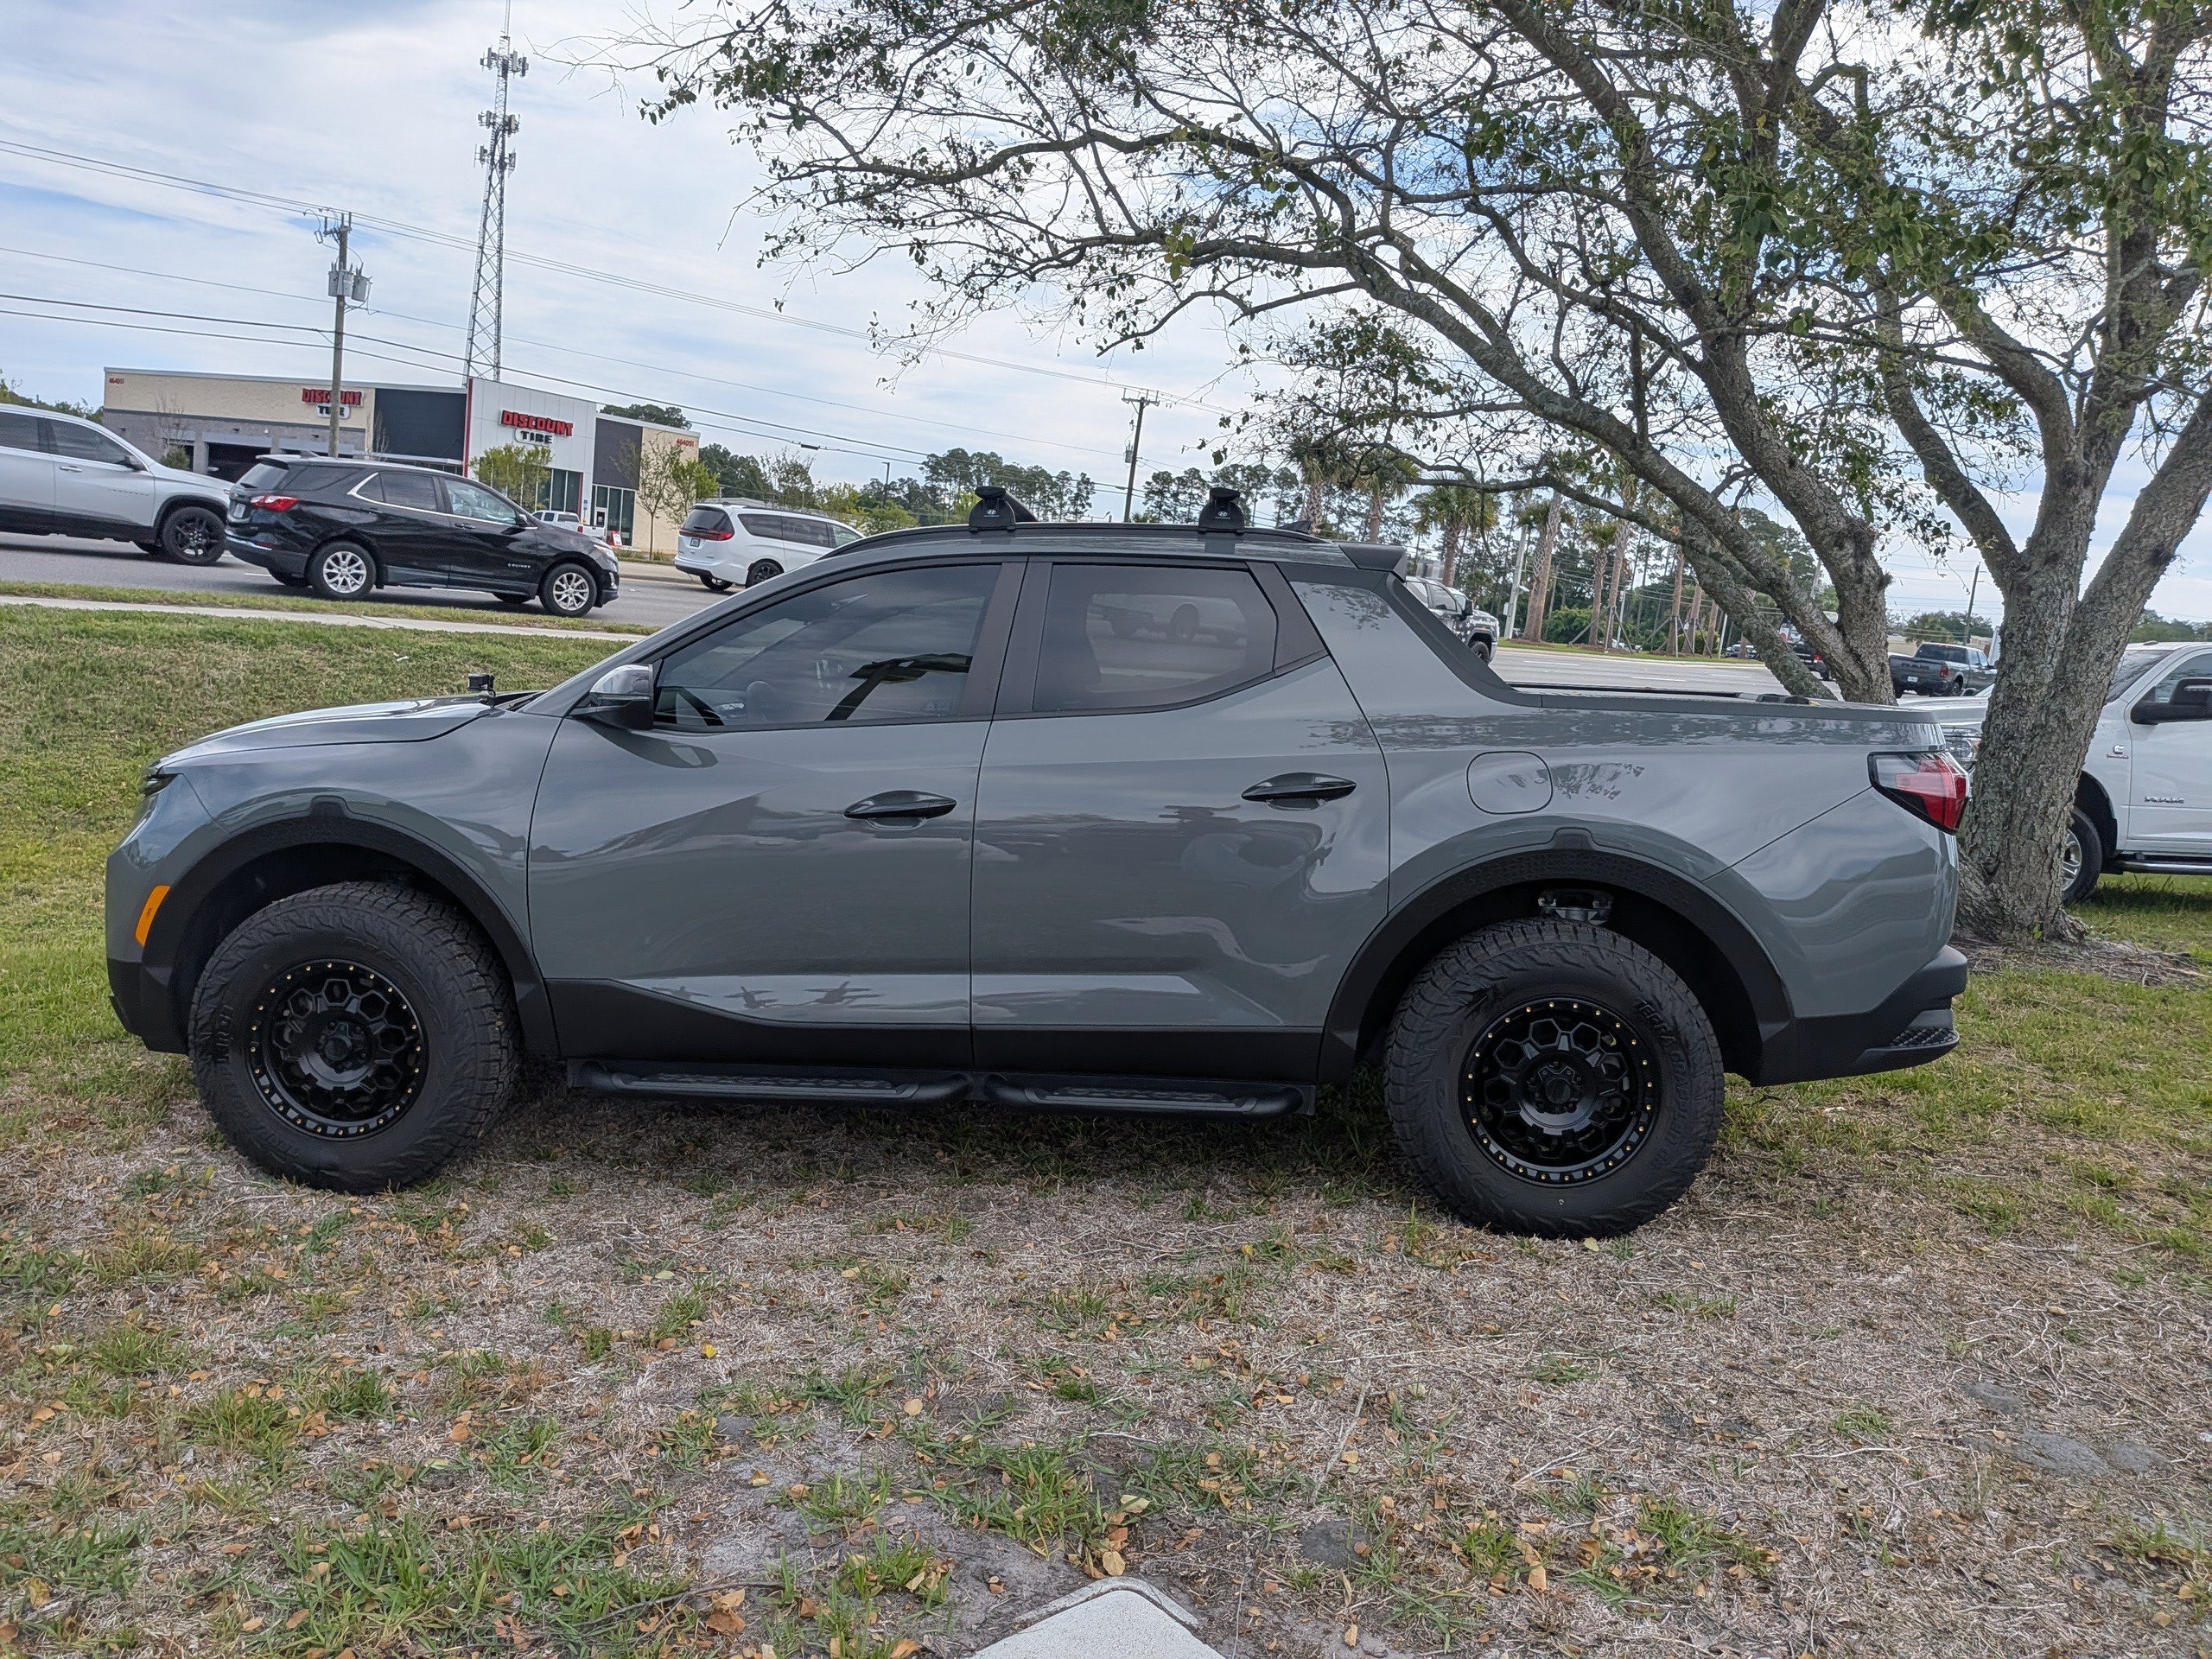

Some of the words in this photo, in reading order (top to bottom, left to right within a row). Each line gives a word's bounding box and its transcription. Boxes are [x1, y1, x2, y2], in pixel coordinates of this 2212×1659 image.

[302, 388, 362, 405] DISCUNT
[317, 404, 345, 416] TIE
[501, 410, 573, 436] DISCOUNT
[520, 430, 553, 444] TIRE
